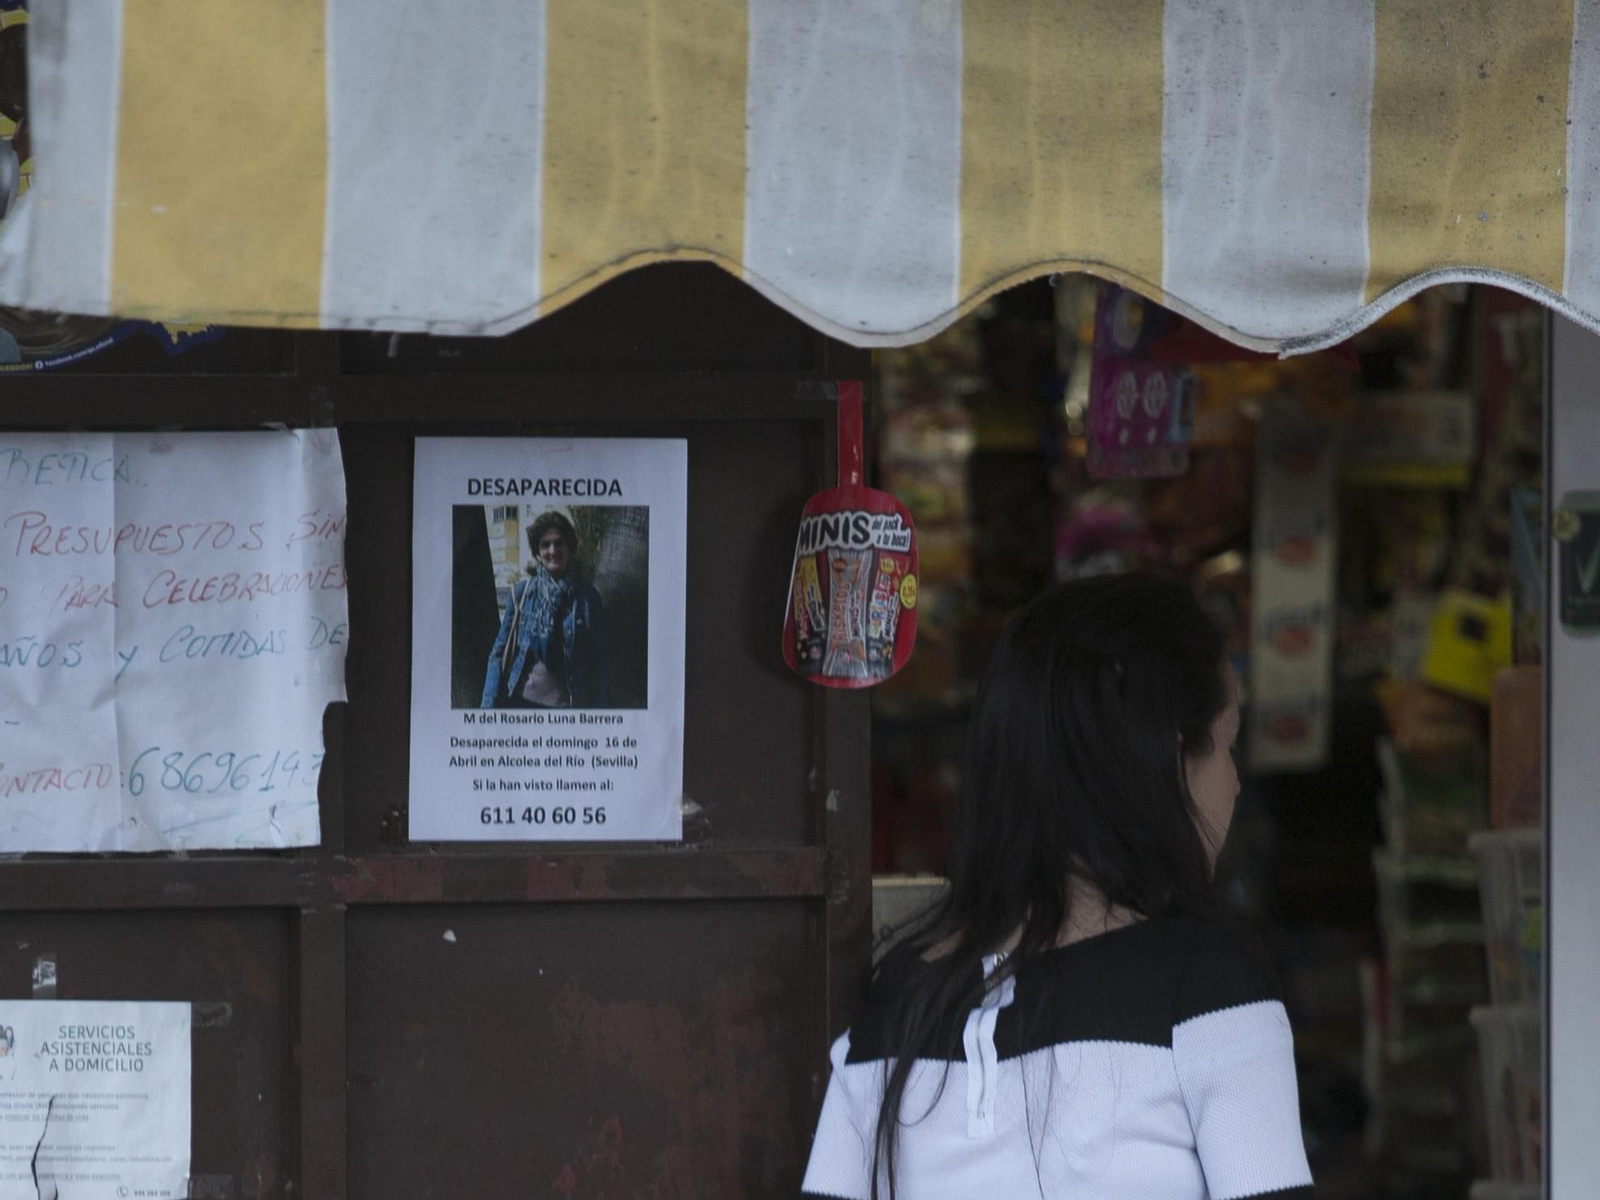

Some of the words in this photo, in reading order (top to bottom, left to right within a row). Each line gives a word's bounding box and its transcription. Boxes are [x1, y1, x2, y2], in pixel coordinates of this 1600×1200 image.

[467, 477, 622, 497] DESAPARECIDA
[3, 511, 265, 557] PRESUPUESTOS
[799, 514, 871, 552] MINIS
[159, 624, 287, 663] COMIDAS
[308, 616, 347, 647] DE
[463, 713, 475, 724] M
[479, 712, 497, 724] del
[501, 712, 545, 724] Rosario
[548, 713, 575, 724] Luna
[580, 713, 623, 724] Barrera
[450, 736, 529, 750] Desaparecida
[532, 736, 542, 748] el
[546, 736, 598, 750] domingo
[605, 737, 619, 748] 16
[622, 736, 637, 748] de
[449, 755, 477, 768] Abril
[480, 758, 495, 768] en
[497, 755, 541, 768] Alcolea
[544, 755, 562, 768] del
[566, 755, 585, 768] Río
[591, 755, 638, 770] (Sevilla)
[472, 778, 483, 791] Si
[486, 778, 496, 791] la
[499, 778, 521, 791] han
[524, 778, 553, 791] visto
[556, 778, 596, 791] llamen
[600, 778, 614, 791] al:
[480, 807, 515, 824] 611
[521, 807, 546, 824] 40
[552, 807, 576, 824] 60
[583, 807, 606, 824] 56
[58, 1025, 135, 1040] SERVICIOS
[40, 1041, 152, 1056] ASISTENCIALES
[49, 1058, 59, 1072] A
[64, 1058, 144, 1072] DOMICILIO
